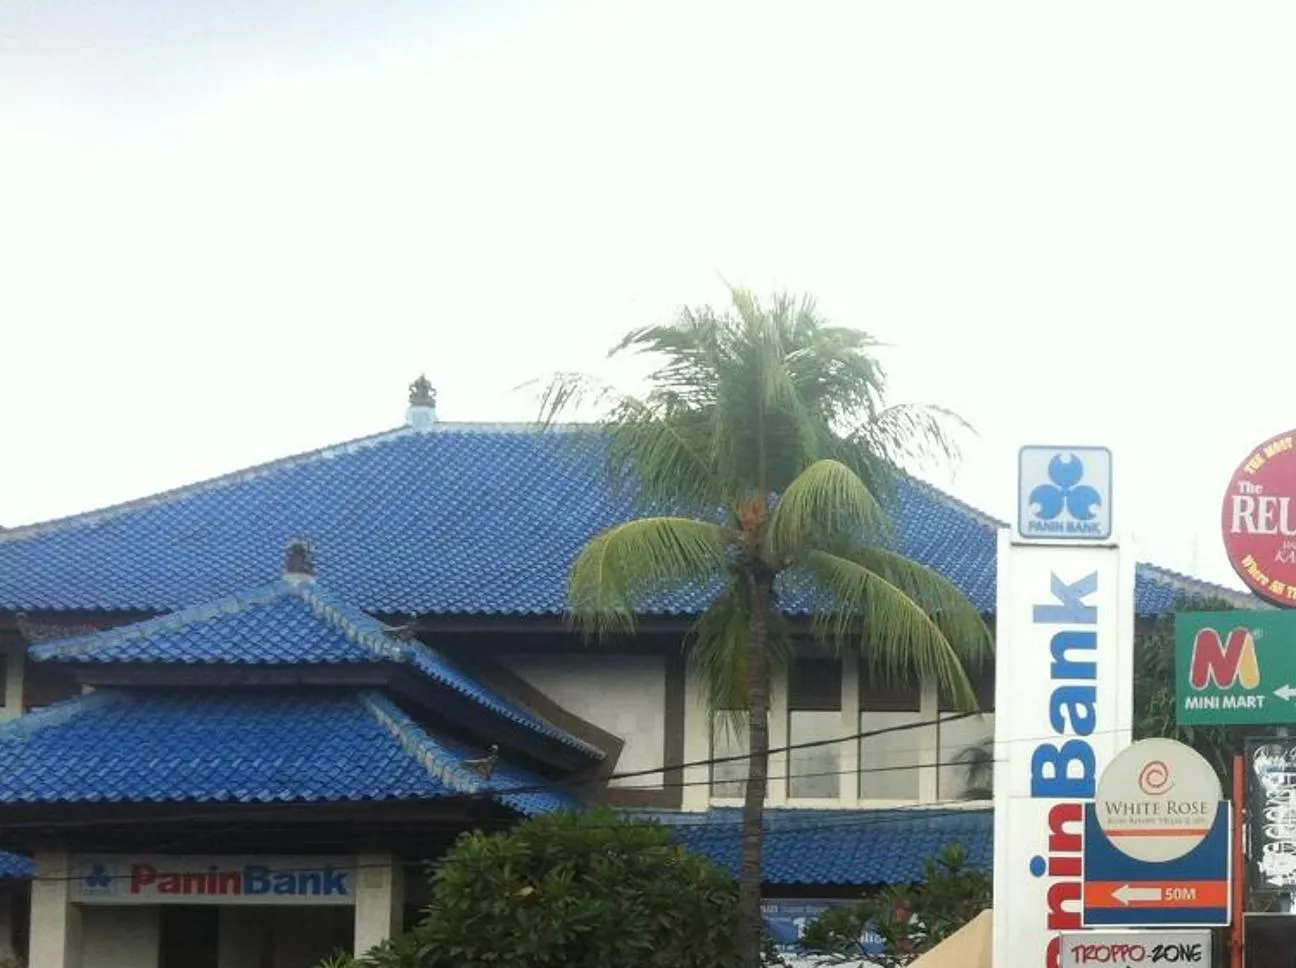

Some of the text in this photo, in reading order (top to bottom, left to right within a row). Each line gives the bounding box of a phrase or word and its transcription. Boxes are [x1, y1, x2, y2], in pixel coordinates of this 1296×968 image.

[1237, 480, 1264, 495] The
[1065, 520, 1102, 535] BANK
[1241, 553, 1270, 586] Where
[1184, 695, 1265, 710] MINI MART
[1104, 800, 1209, 816] WHITE ROSE
[1164, 887, 1197, 901] 50M
